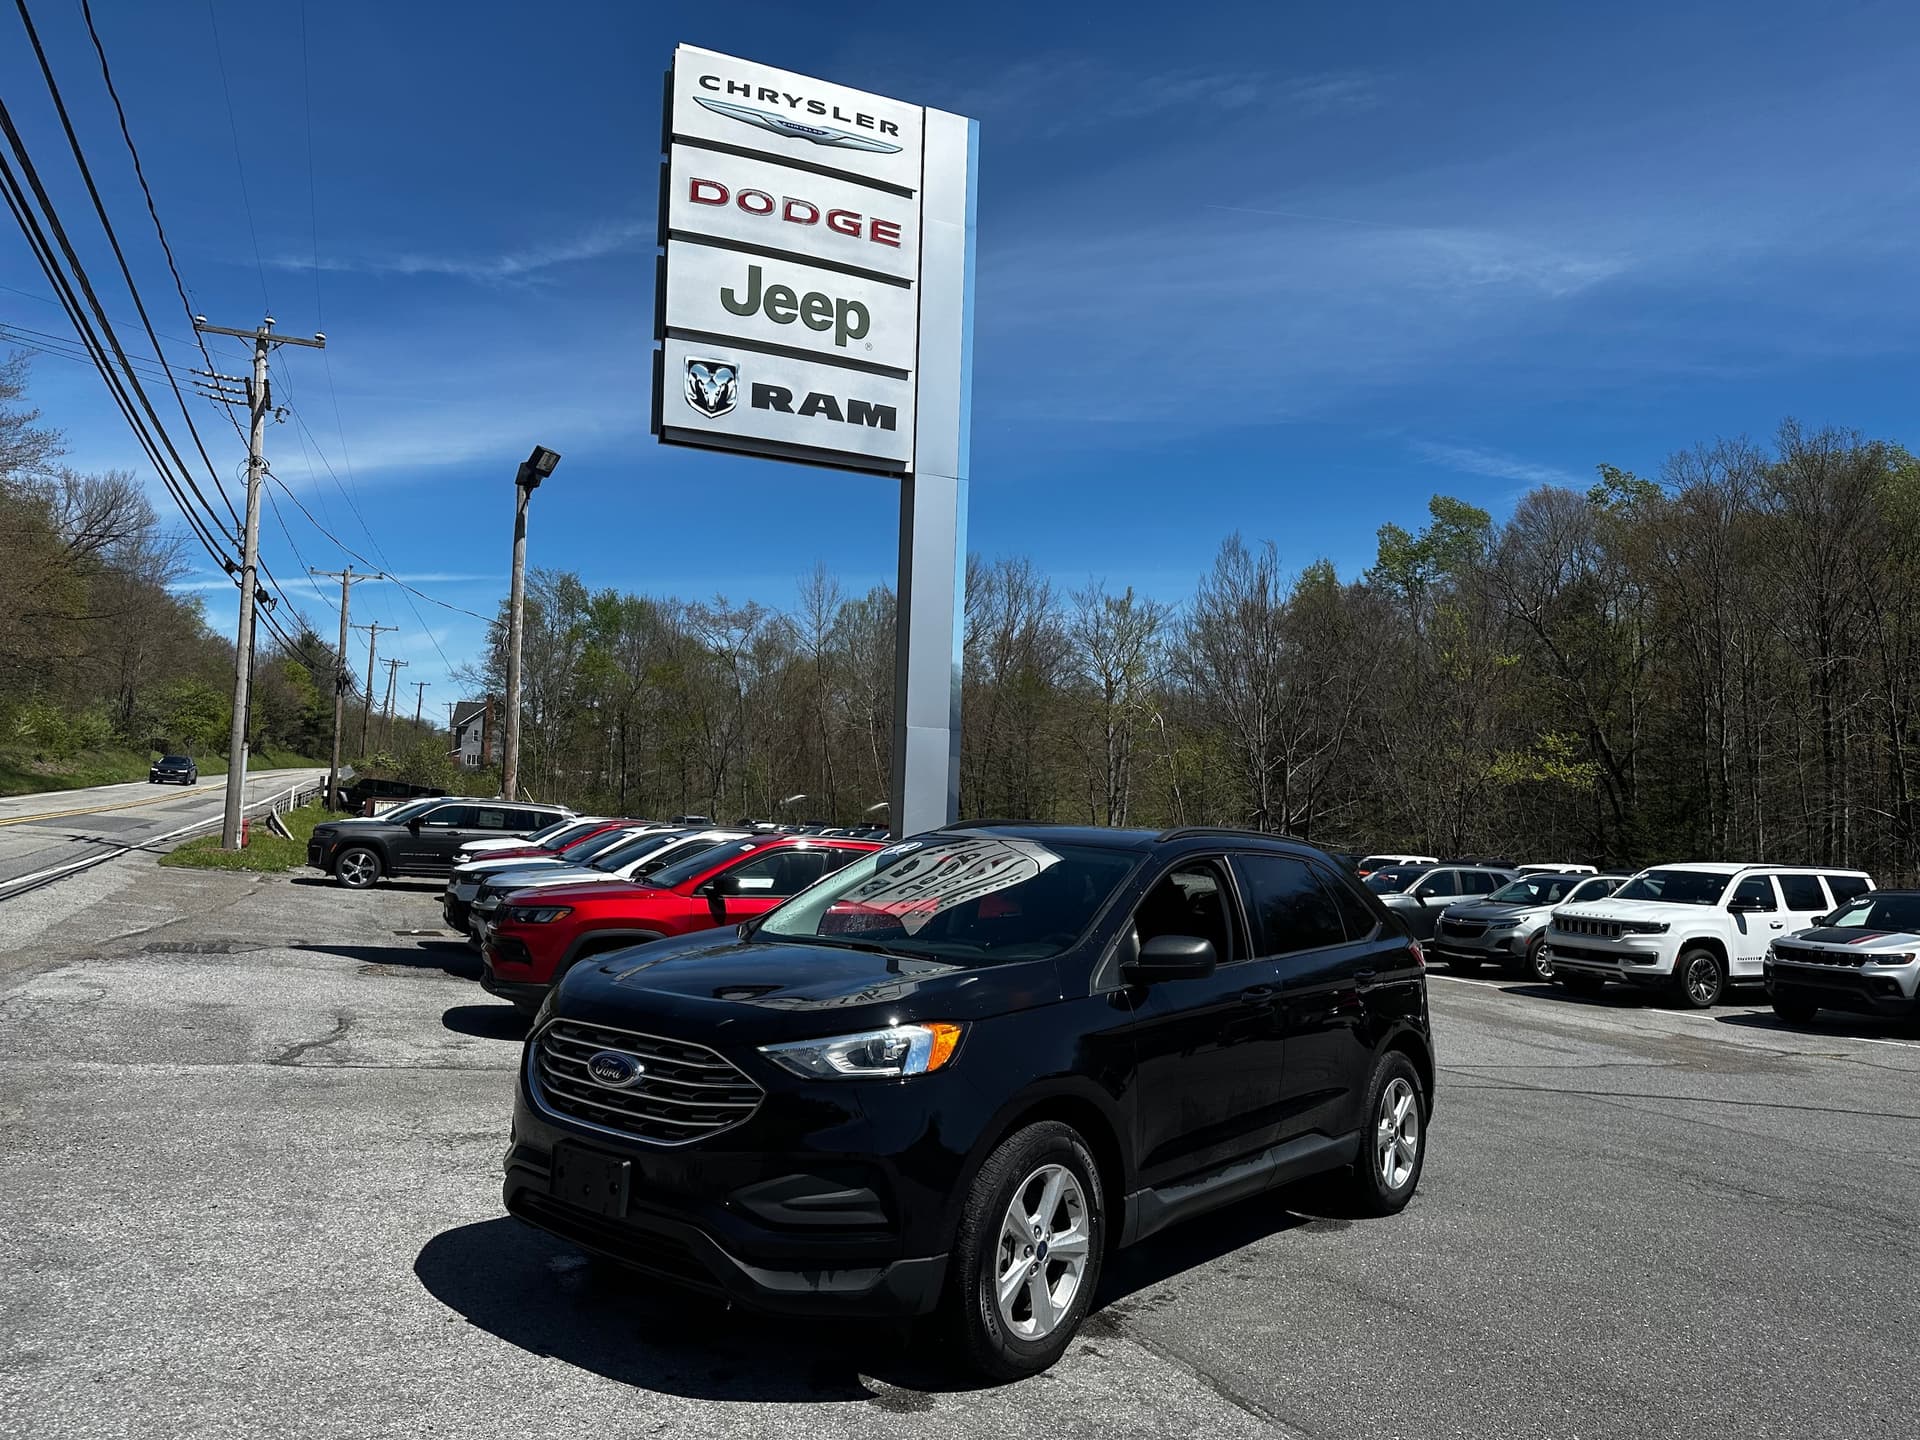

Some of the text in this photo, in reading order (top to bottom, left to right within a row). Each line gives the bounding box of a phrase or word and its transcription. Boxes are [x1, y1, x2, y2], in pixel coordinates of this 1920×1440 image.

[698, 75, 899, 137] CHRYSLER
[689, 177, 902, 248] DODGE
[720, 264, 871, 347] Jeep
[751, 382, 897, 432] RAM
[595, 1057, 624, 1079] Ford
